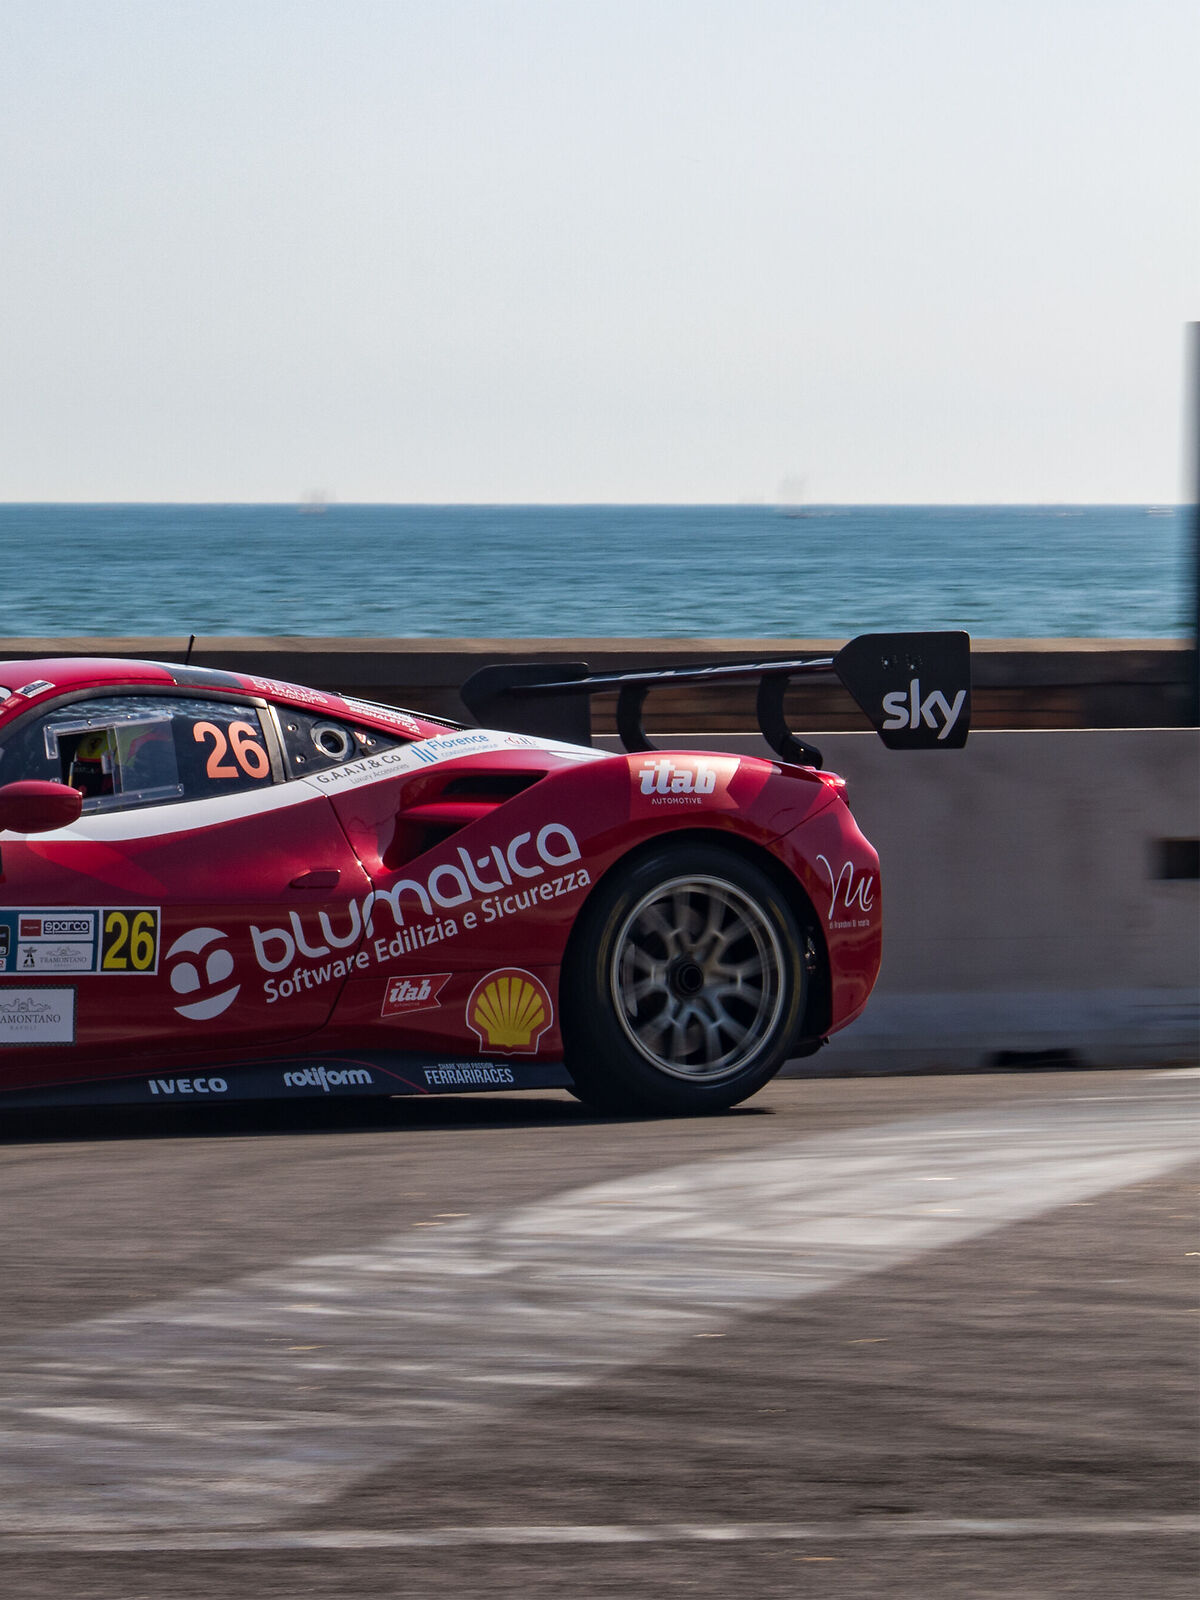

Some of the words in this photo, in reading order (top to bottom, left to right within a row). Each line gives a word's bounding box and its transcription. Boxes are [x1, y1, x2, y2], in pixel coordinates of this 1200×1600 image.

[882, 679, 967, 740] sky
[193, 721, 270, 779] 26
[427, 733, 490, 752] Florence
[639, 759, 717, 795] itab
[652, 797, 703, 805] AUTOMOTIVE
[249, 823, 582, 973] blumatica
[44, 921, 89, 934] sparco
[263, 951, 369, 1004] Software
[374, 917, 459, 963] Edilizia
[463, 910, 478, 929] e
[481, 868, 591, 923] Sicurezza
[103, 912, 155, 970] 26
[389, 980, 432, 1002] itab
[148, 1077, 228, 1095] IVECO
[283, 1066, 374, 1092] rotiform
[424, 1068, 514, 1085] FERRARIRACES
